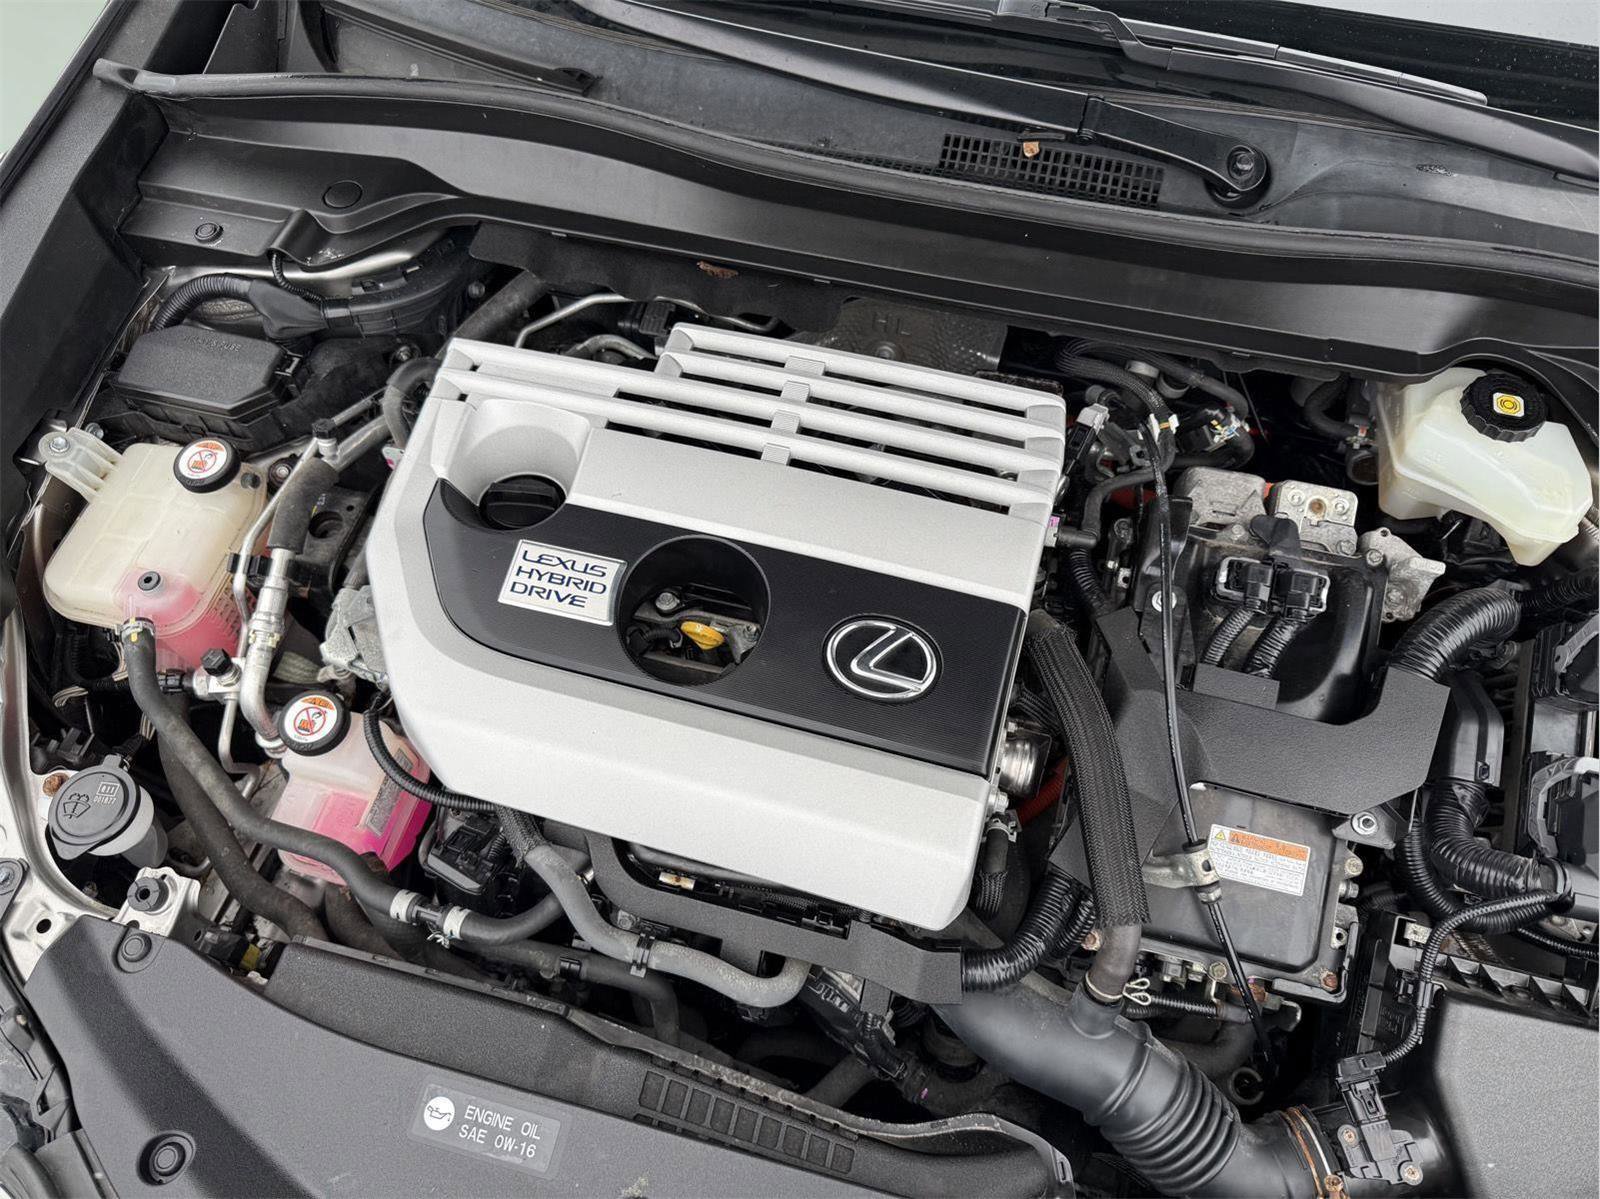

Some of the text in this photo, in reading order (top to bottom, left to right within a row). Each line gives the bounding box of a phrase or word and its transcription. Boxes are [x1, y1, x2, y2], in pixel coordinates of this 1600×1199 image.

[522, 550, 608, 578] LEXUS
[509, 581, 588, 609] DRIVE
[515, 565, 607, 595] HYBRID
[464, 1104, 541, 1140] ENGINE OIL
[458, 1124, 537, 1158] SAE 0W-16
